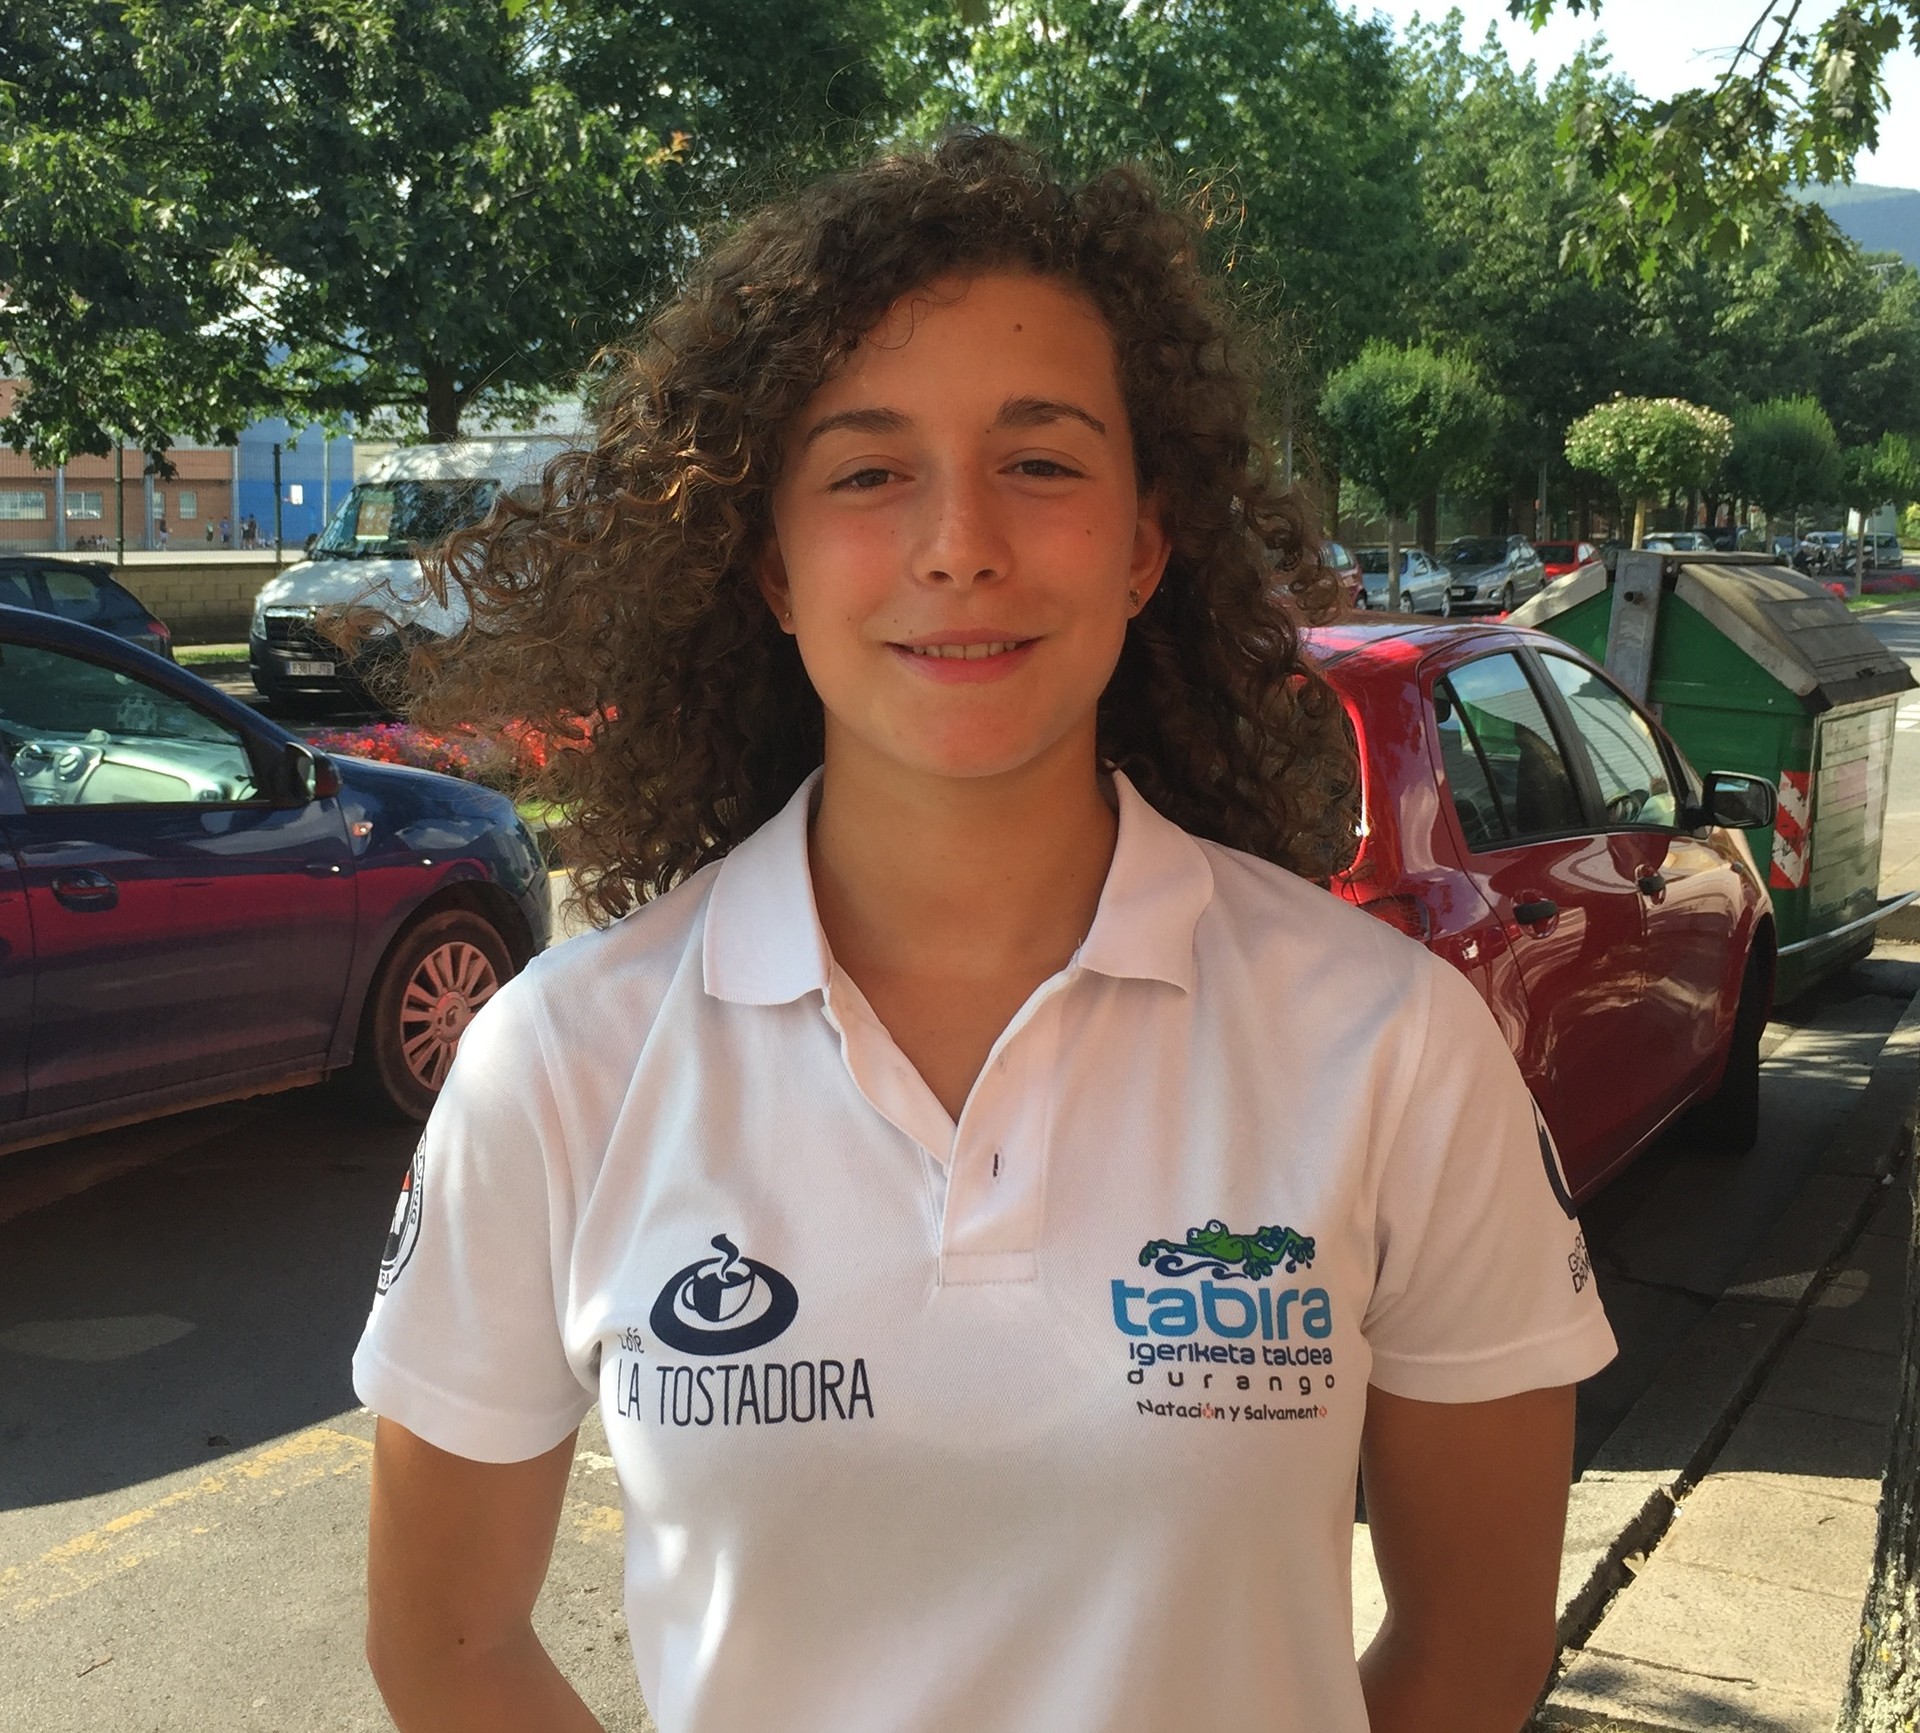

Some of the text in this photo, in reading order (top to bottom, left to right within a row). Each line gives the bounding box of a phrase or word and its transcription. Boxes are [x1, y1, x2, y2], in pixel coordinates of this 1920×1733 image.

[1111, 1279, 1332, 1340] tabira
[1262, 1346, 1333, 1366] taldea
[617, 1358, 874, 1426] LA TOSTADORA
